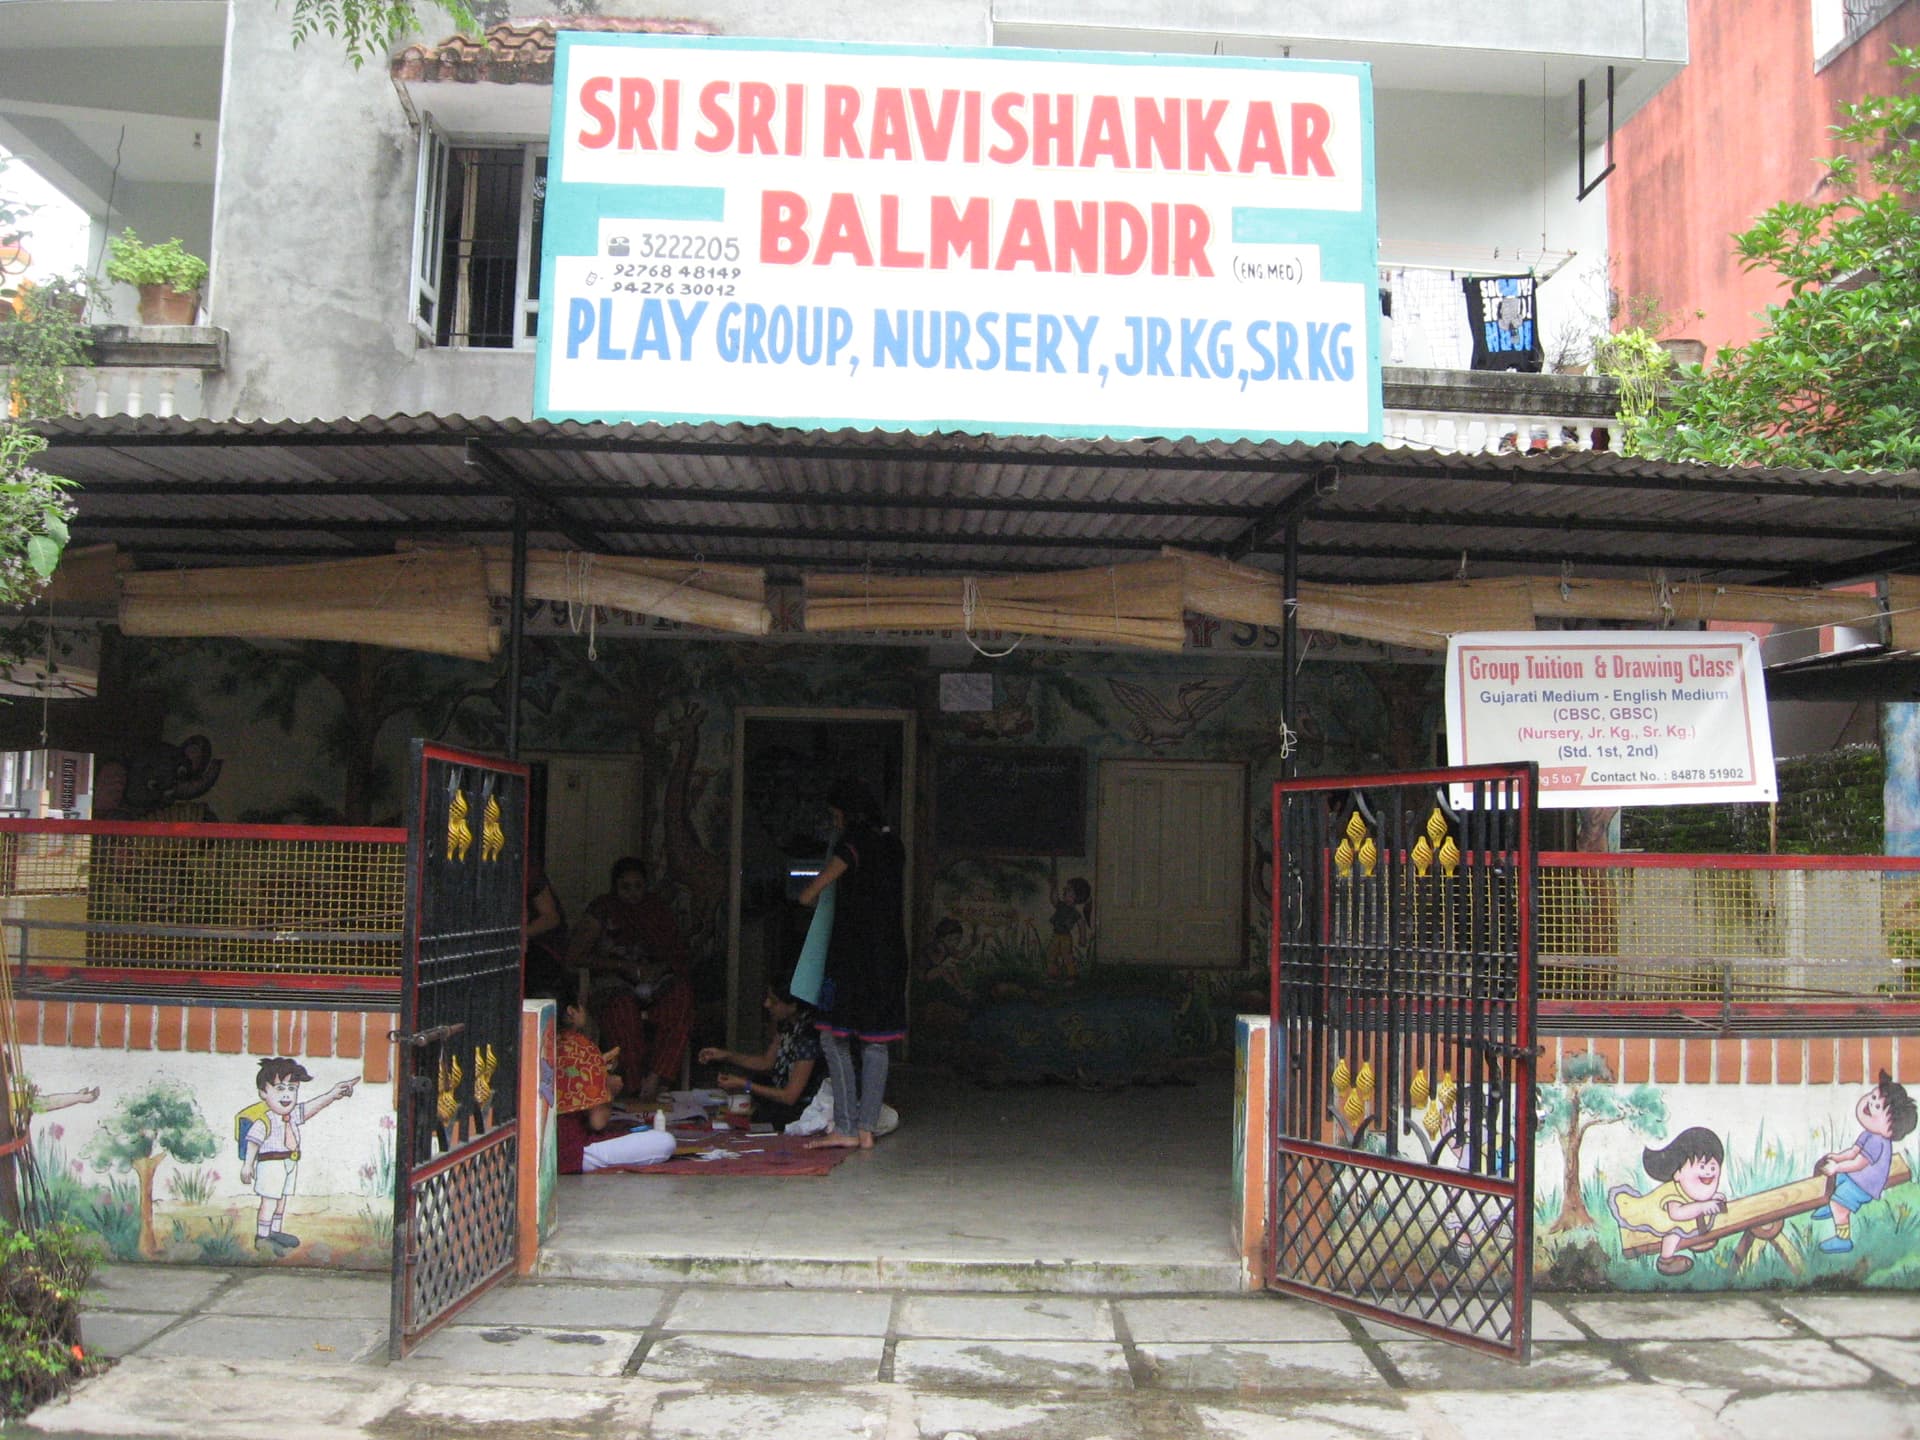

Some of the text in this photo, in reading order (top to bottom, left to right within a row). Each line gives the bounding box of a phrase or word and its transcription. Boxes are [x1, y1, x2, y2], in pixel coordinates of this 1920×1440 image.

[578, 76, 1336, 177] SRI SRI RAVISHANKAR
[760, 190, 1215, 278] BALMANDIR
[640, 233, 740, 262] 3222205
[613, 264, 741, 280] 92768 48149
[611, 281, 736, 297] 94276 30012
[565, 297, 709, 362] PLAY
[716, 301, 860, 378] GROUP,
[1469, 653, 1735, 685] Group Tuition & Drawing Class
[1480, 690, 1538, 706] Gujarati
[1542, 689, 1599, 703] Medium
[1613, 688, 1667, 704] English
[1671, 687, 1729, 702] Medium
[1610, 706, 1658, 721] GBSC)
[1518, 726, 1584, 743] (Nursery,
[1588, 726, 1606, 739] Jr.
[1643, 725, 1662, 738] Sr.
[1558, 744, 1658, 760] (Std. 1st, 2nd)
[1552, 773, 1559, 784] 5
[1561, 773, 1572, 784] to
[1574, 772, 1581, 784] 7
[1591, 771, 1636, 782] Contact
[1640, 770, 1660, 781] No.
[1671, 769, 1706, 780] 84878
[1709, 768, 1744, 779] 51902
